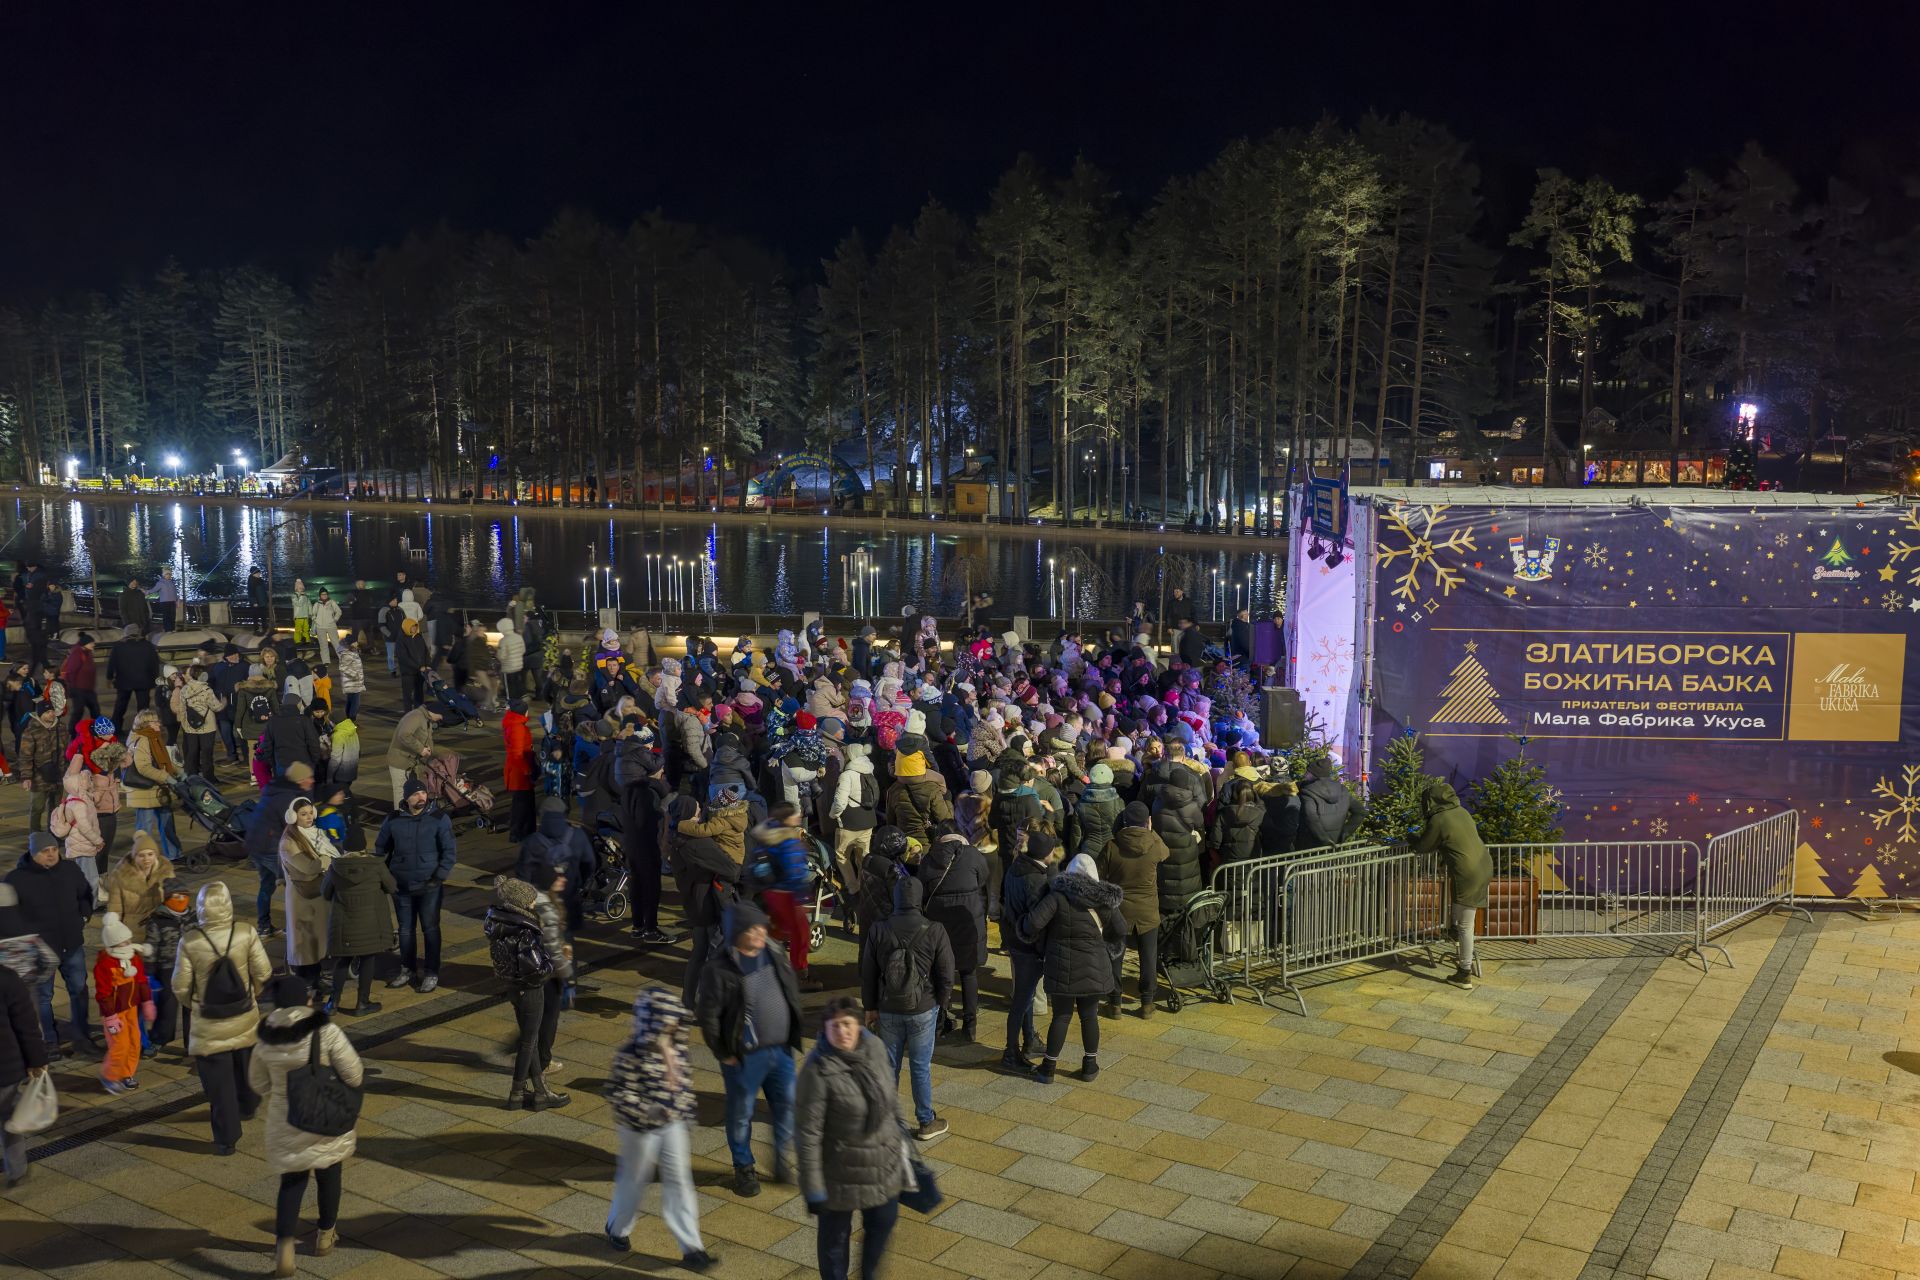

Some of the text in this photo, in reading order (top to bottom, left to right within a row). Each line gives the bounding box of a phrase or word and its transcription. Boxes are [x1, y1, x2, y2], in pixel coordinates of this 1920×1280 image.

[1525, 642, 1776, 666] ЗЛАТИБОРСКА
[1524, 672, 1773, 693] БОЖИЋНА БАЈКА
[1814, 663, 1866, 684] Mala
[1829, 684, 1880, 698] FABRIKA
[1562, 700, 1744, 712] ПРИЈАТЕЉИ ФЕСТИВАЛА
[1820, 697, 1859, 711] UKUSA
[1534, 711, 1766, 730] Мала Фабрика Укуса
